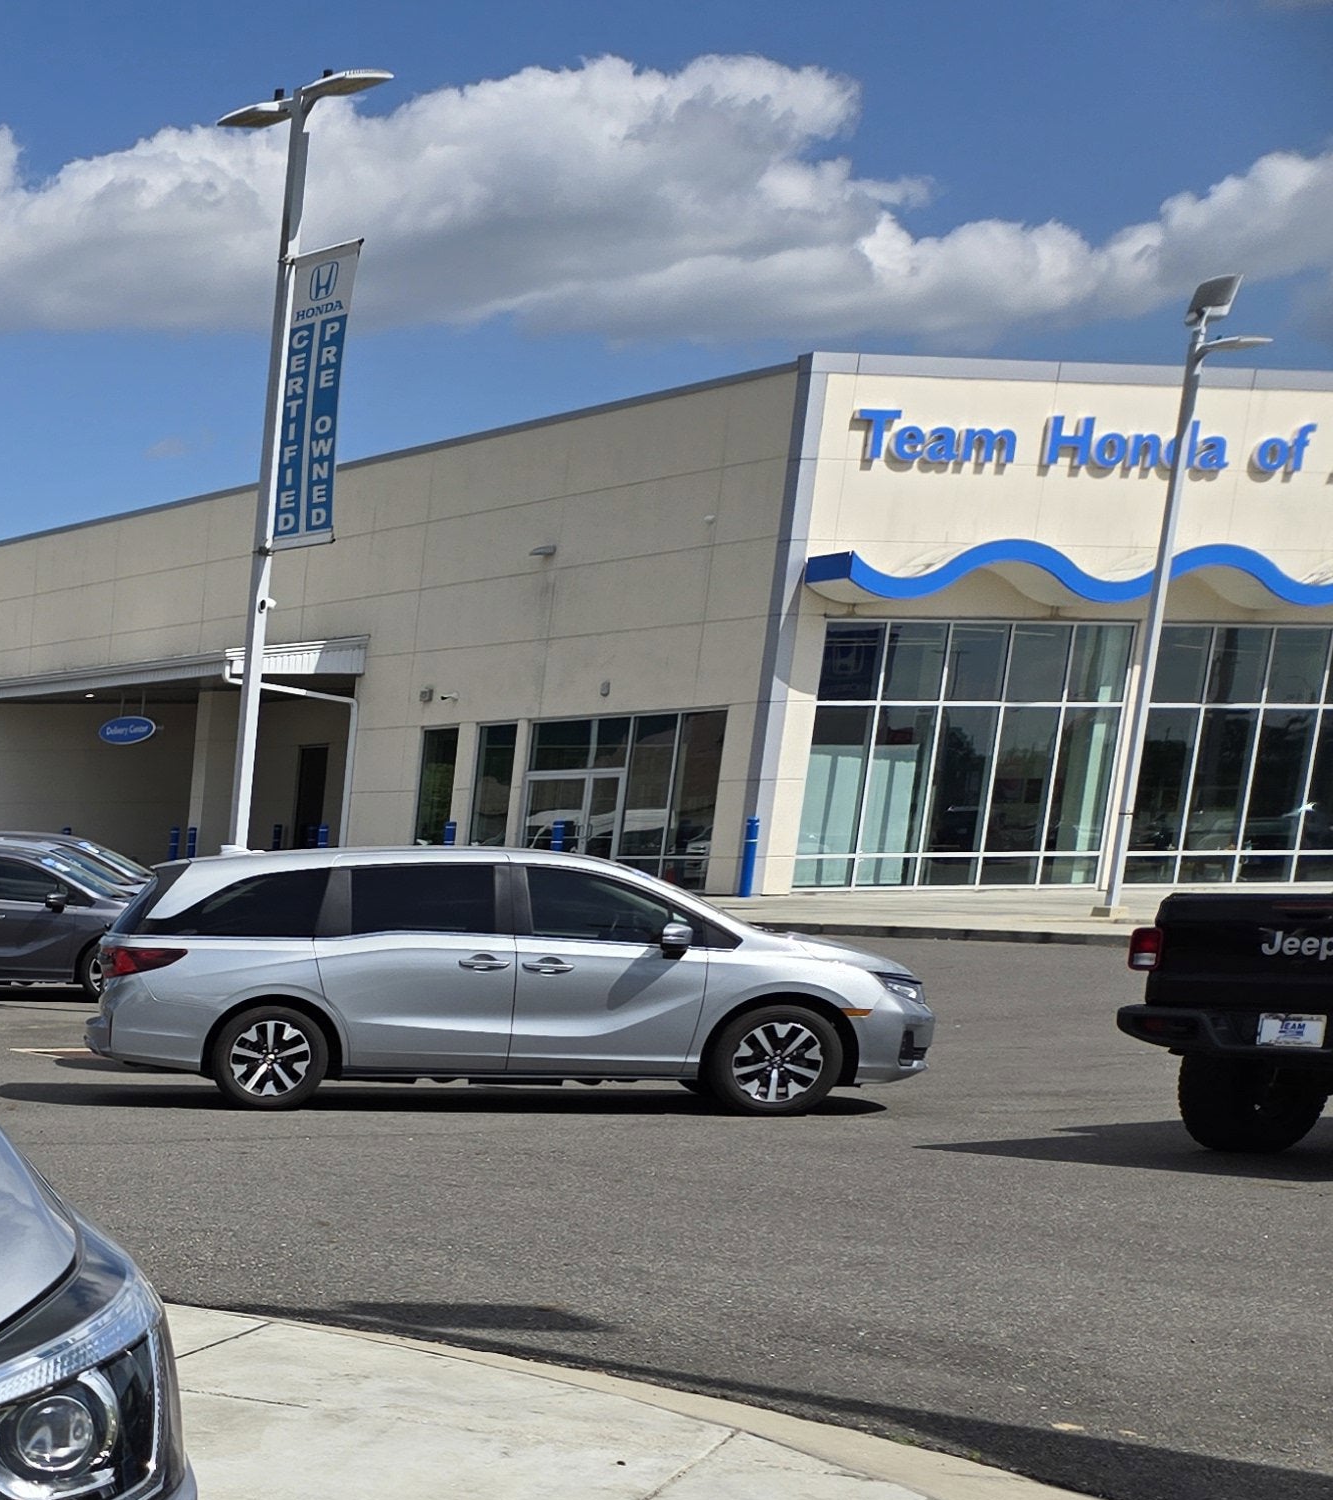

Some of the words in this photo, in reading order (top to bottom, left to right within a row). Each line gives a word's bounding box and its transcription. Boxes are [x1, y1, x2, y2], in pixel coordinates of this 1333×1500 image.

[295, 299, 345, 322] HONDA
[319, 321, 341, 388] PRE
[278, 329, 310, 532] CERTIFIED
[856, 408, 1018, 465] Team
[1045, 415, 1229, 471] Honda
[1257, 422, 1318, 473] of
[311, 415, 333, 526] OWNED
[106, 726, 129, 736] Delivery
